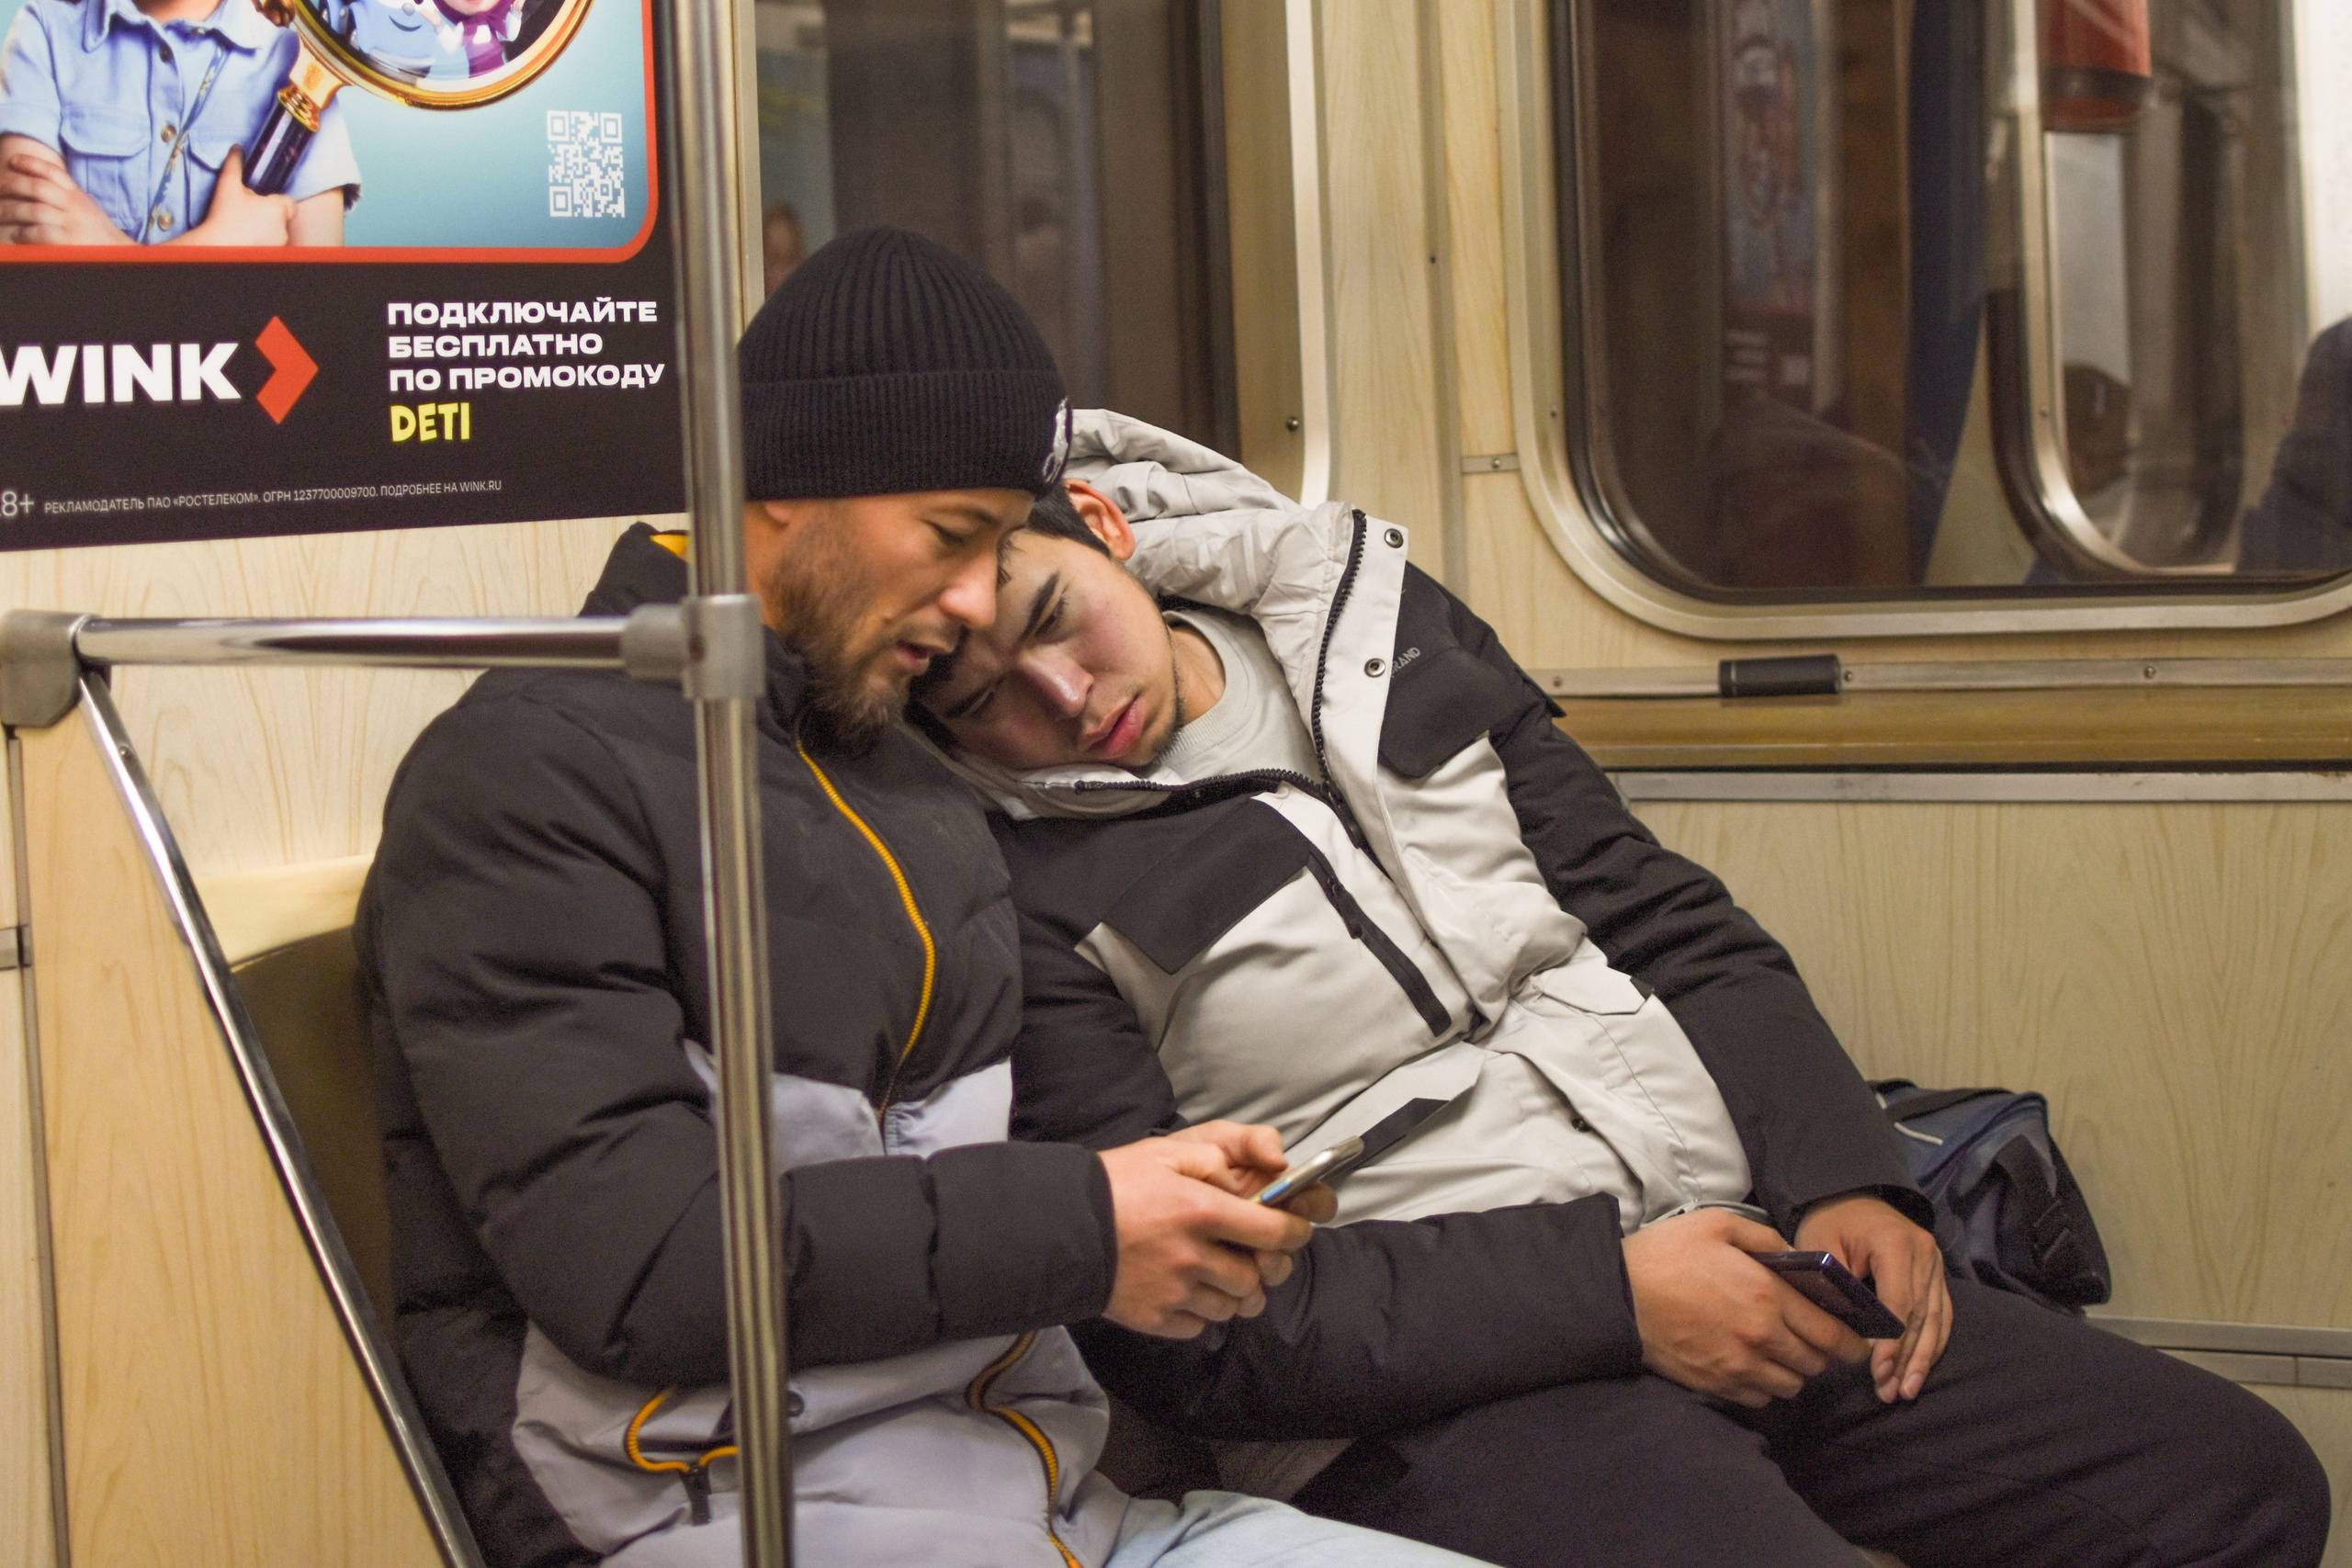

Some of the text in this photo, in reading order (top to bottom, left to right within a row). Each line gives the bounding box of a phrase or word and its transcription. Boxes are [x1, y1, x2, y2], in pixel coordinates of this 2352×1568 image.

[388, 297, 658, 328] ПОДКЛЮЧАЙТЕ
[389, 333, 604, 358] БЕСПЛАТНО
[0, 343, 242, 406] WINK
[390, 363, 666, 391] ПО ПРОМОКОДУ
[390, 401, 470, 442] DETI
[0, 491, 35, 516] 8+
[45, 479, 503, 514] РЕКЛАМОДАТЕЛЬ ПАО «РОСТЕЛЕКОМ». ОГРН 1237700009700. ПОДРОБНЕЕ НА WINK.RU
